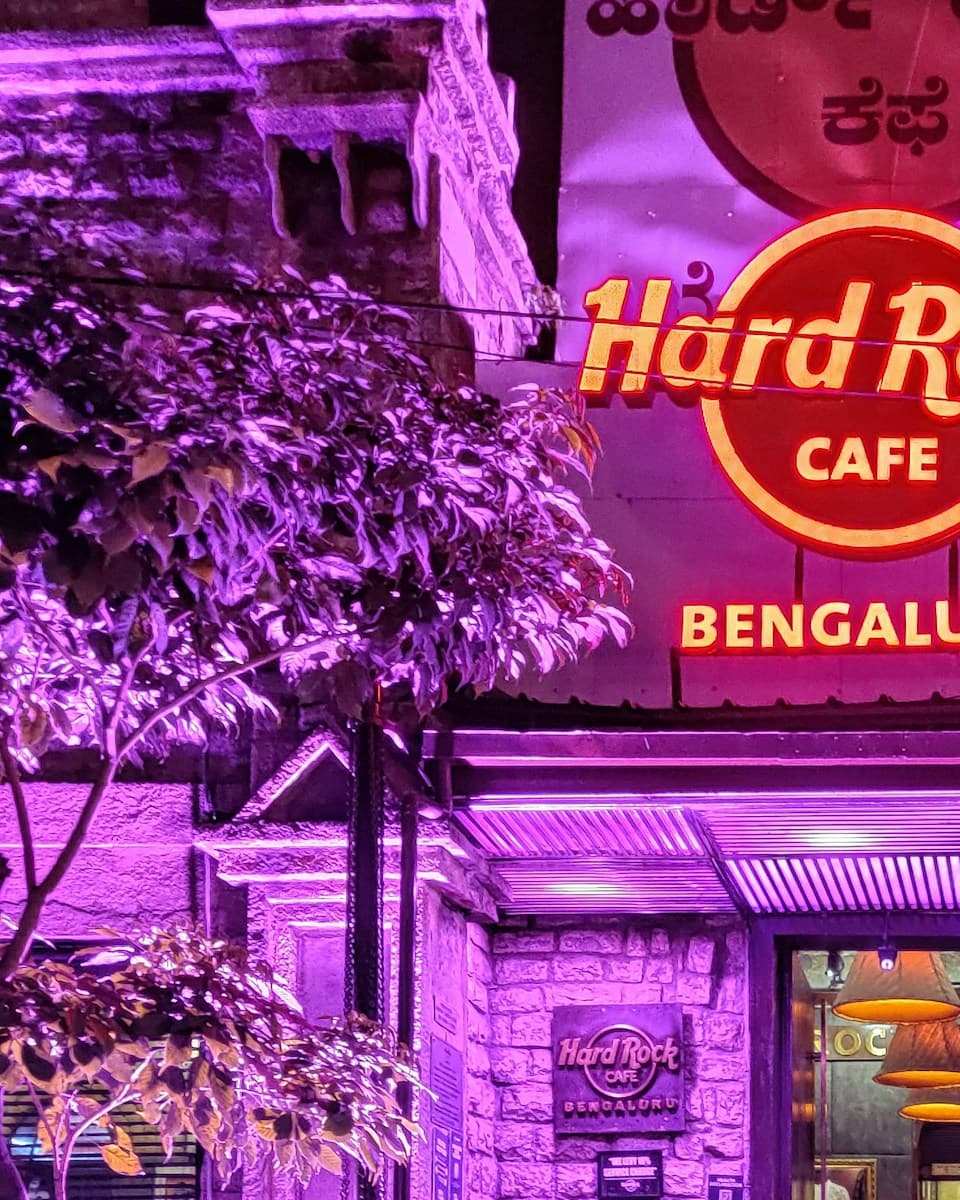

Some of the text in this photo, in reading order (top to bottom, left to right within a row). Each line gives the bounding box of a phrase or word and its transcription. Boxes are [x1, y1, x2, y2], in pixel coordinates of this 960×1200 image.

[580, 279, 873, 394] Hard
[795, 435, 939, 482] CAFE
[558, 1037, 679, 1070] Hard Rock
[605, 1070, 639, 1083] CAFE
[564, 1099, 679, 1112] BENGALURU
